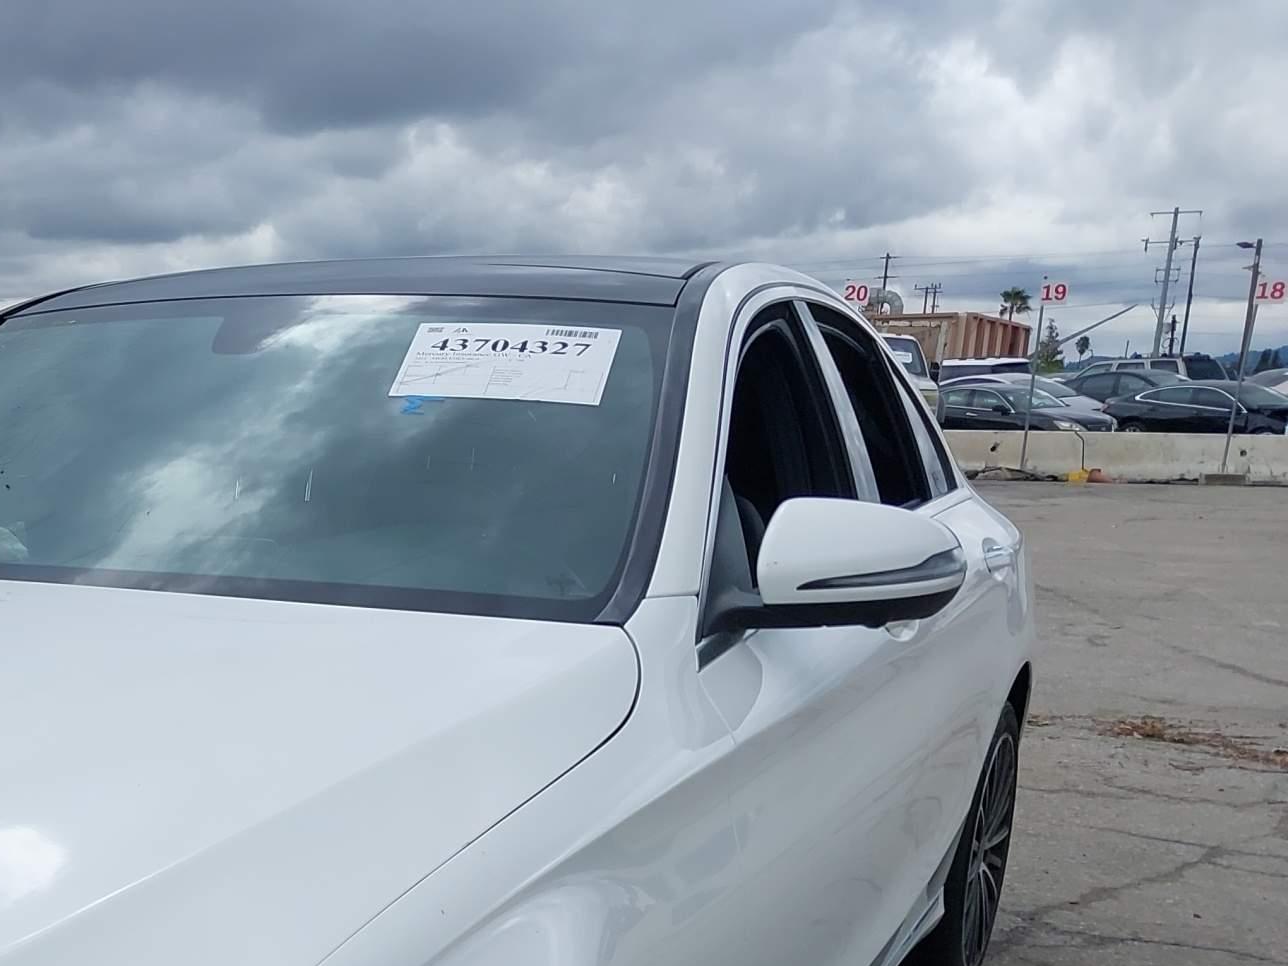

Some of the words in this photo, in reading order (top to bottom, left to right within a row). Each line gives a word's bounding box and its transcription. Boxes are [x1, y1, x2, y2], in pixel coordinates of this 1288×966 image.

[843, 284, 868, 302] 20
[1041, 284, 1067, 301] 19
[1256, 282, 1285, 299] 18
[430, 338, 592, 357] 43704327
